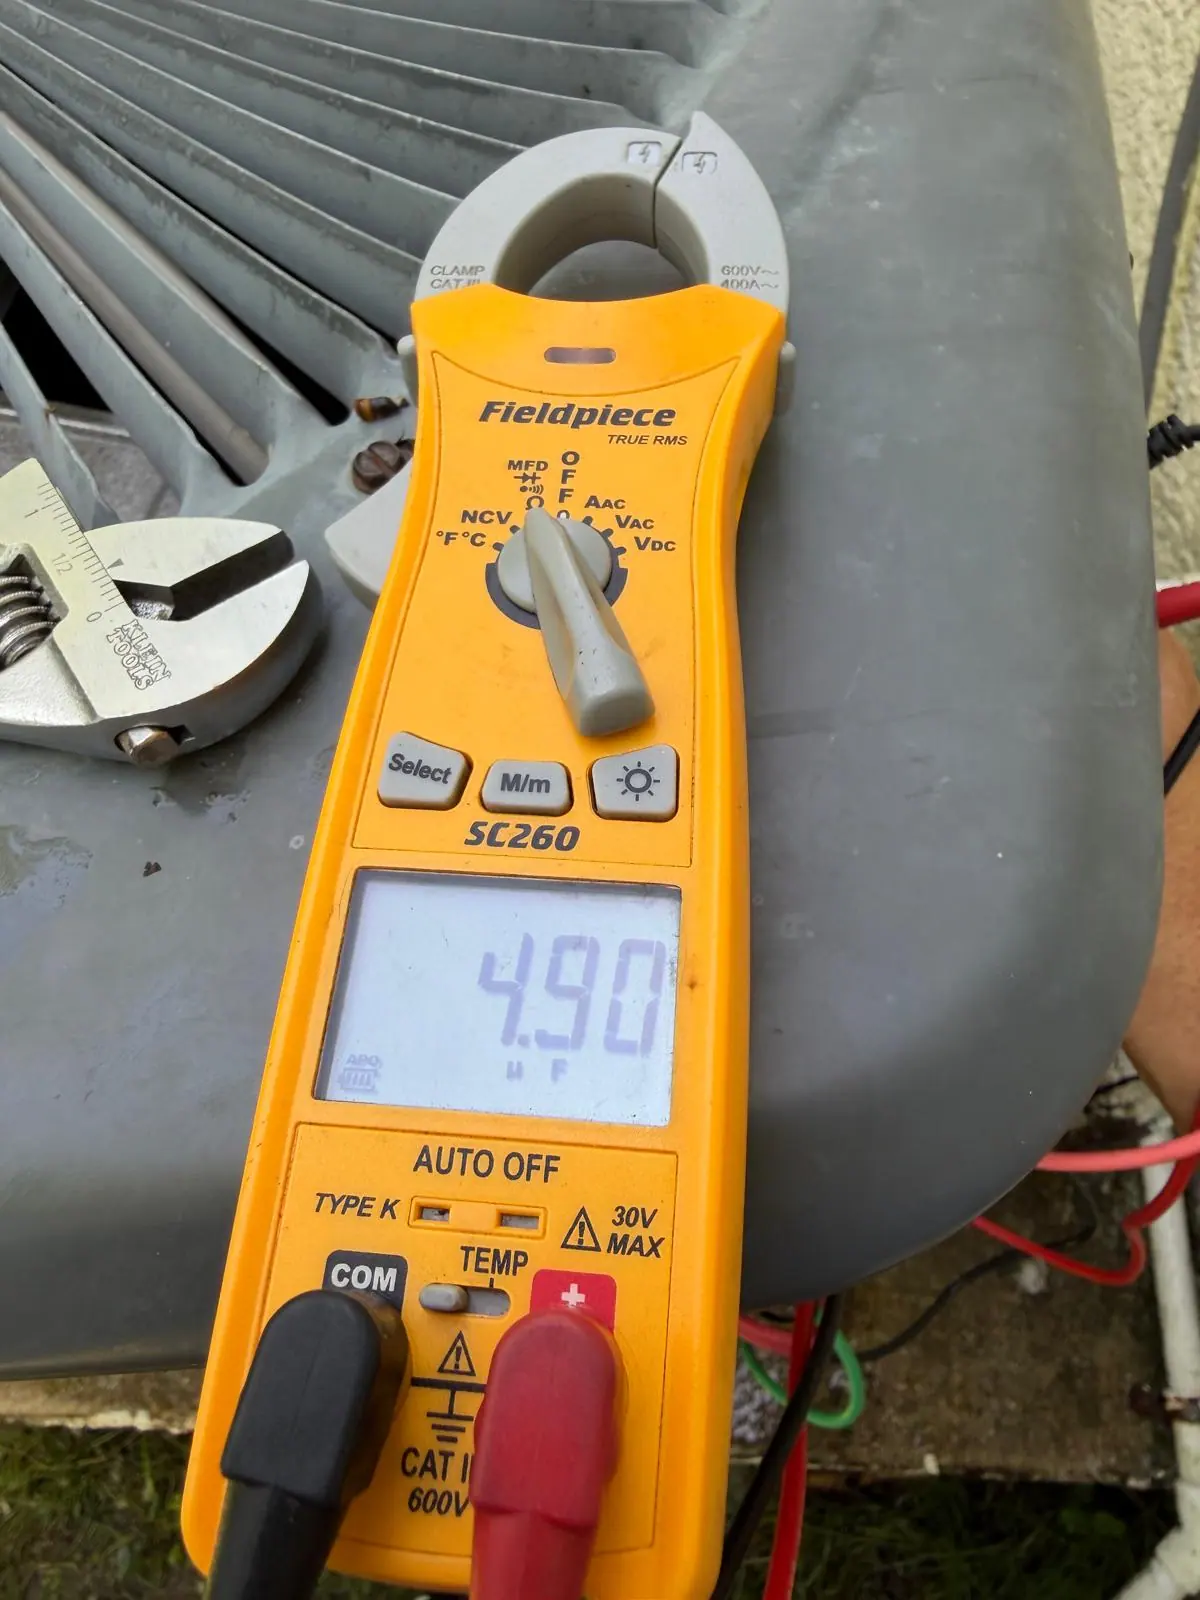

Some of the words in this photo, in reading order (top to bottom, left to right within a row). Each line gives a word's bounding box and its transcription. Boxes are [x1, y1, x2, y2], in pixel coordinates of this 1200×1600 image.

[430, 264, 486, 276] CLAMP
[478, 401, 676, 429] Fieldpiece
[607, 434, 649, 445] TRUE
[652, 435, 688, 446] RMS
[507, 460, 548, 472] MFD
[461, 510, 513, 525] NCV
[106, 627, 154, 690] TOOLS
[119, 619, 172, 683] KLEIN
[388, 753, 452, 785] Select
[500, 772, 551, 794] M/m
[464, 820, 581, 851] SC260
[477, 932, 666, 1057] 4.90
[413, 1144, 494, 1178] AUTO
[503, 1151, 561, 1183] OFF
[314, 1192, 376, 1219] TYPE
[379, 1198, 401, 1220] K
[611, 1205, 659, 1229] 30V
[606, 1232, 666, 1259] MAX
[460, 1245, 529, 1276] TEMP
[330, 1263, 398, 1292] COM
[400, 1446, 455, 1482] CAT
[407, 1486, 470, 1517] 600V
